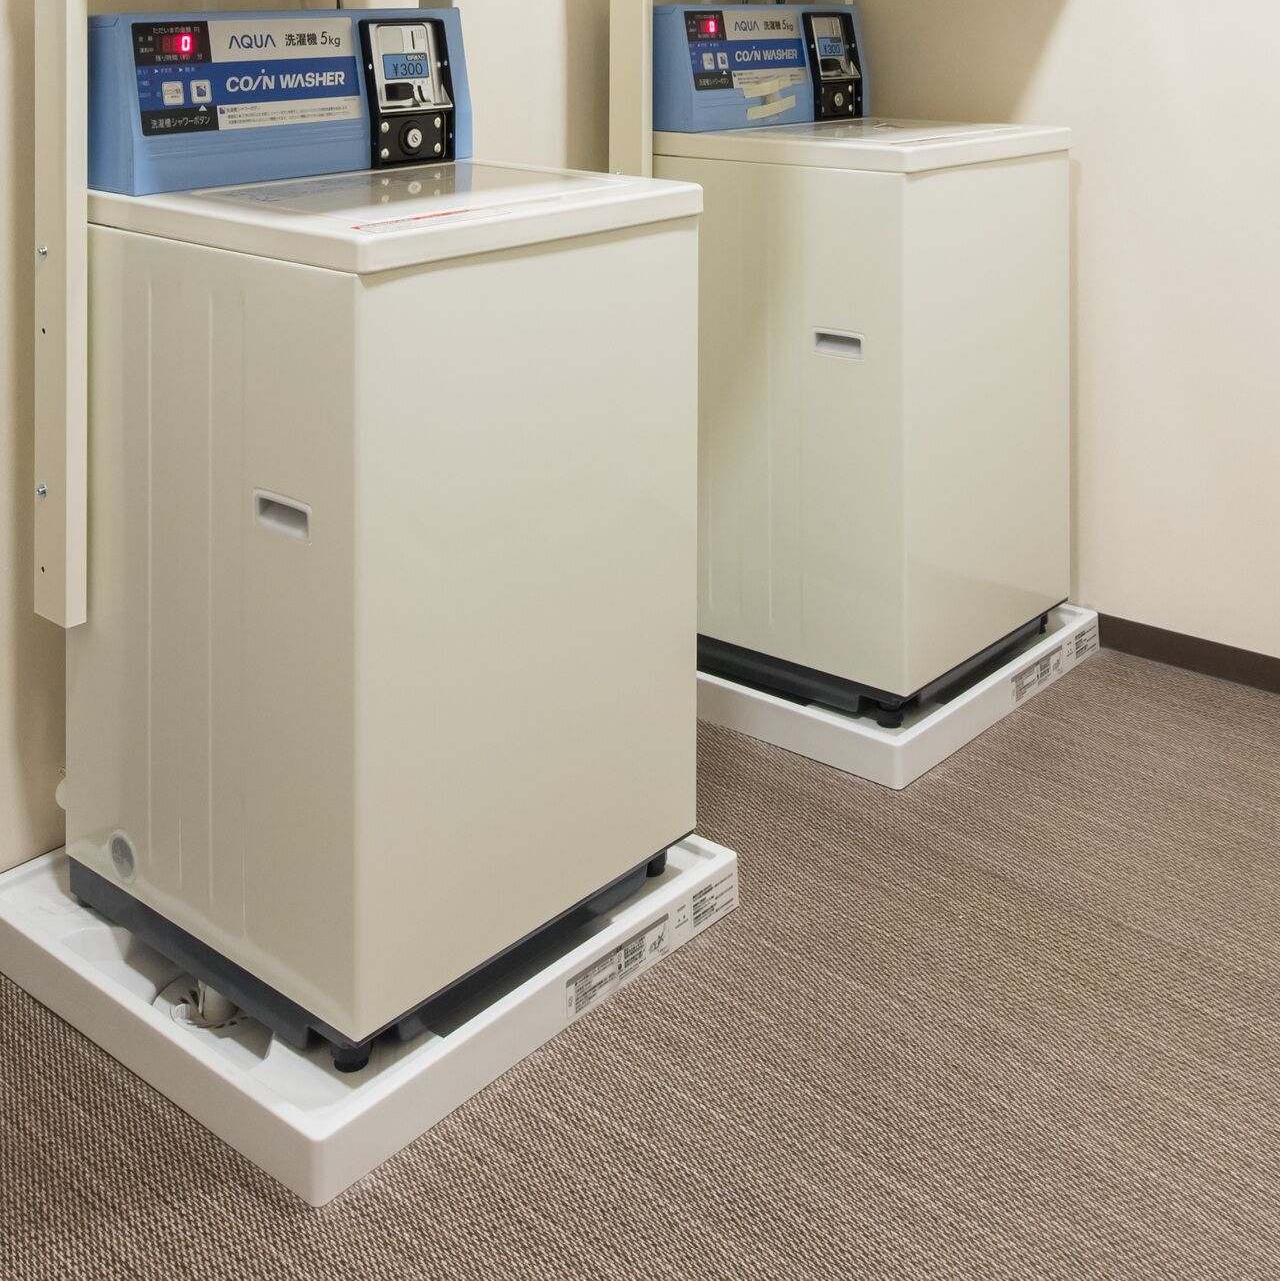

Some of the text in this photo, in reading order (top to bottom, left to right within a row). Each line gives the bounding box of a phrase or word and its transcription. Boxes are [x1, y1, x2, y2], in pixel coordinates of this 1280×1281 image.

[709, 20, 715, 32] 0
[734, 20, 760, 32] AQUA
[763, 20, 782, 31] 洗濯機
[181, 35, 190, 51] 0
[228, 31, 341, 50] AQUA 洗濯機 5kg
[763, 48, 798, 61] WASHER
[392, 62, 424, 77] ¥300
[279, 70, 345, 89] WASHER
[150, 115, 211, 130] 洗濯槽シャワーボタン
